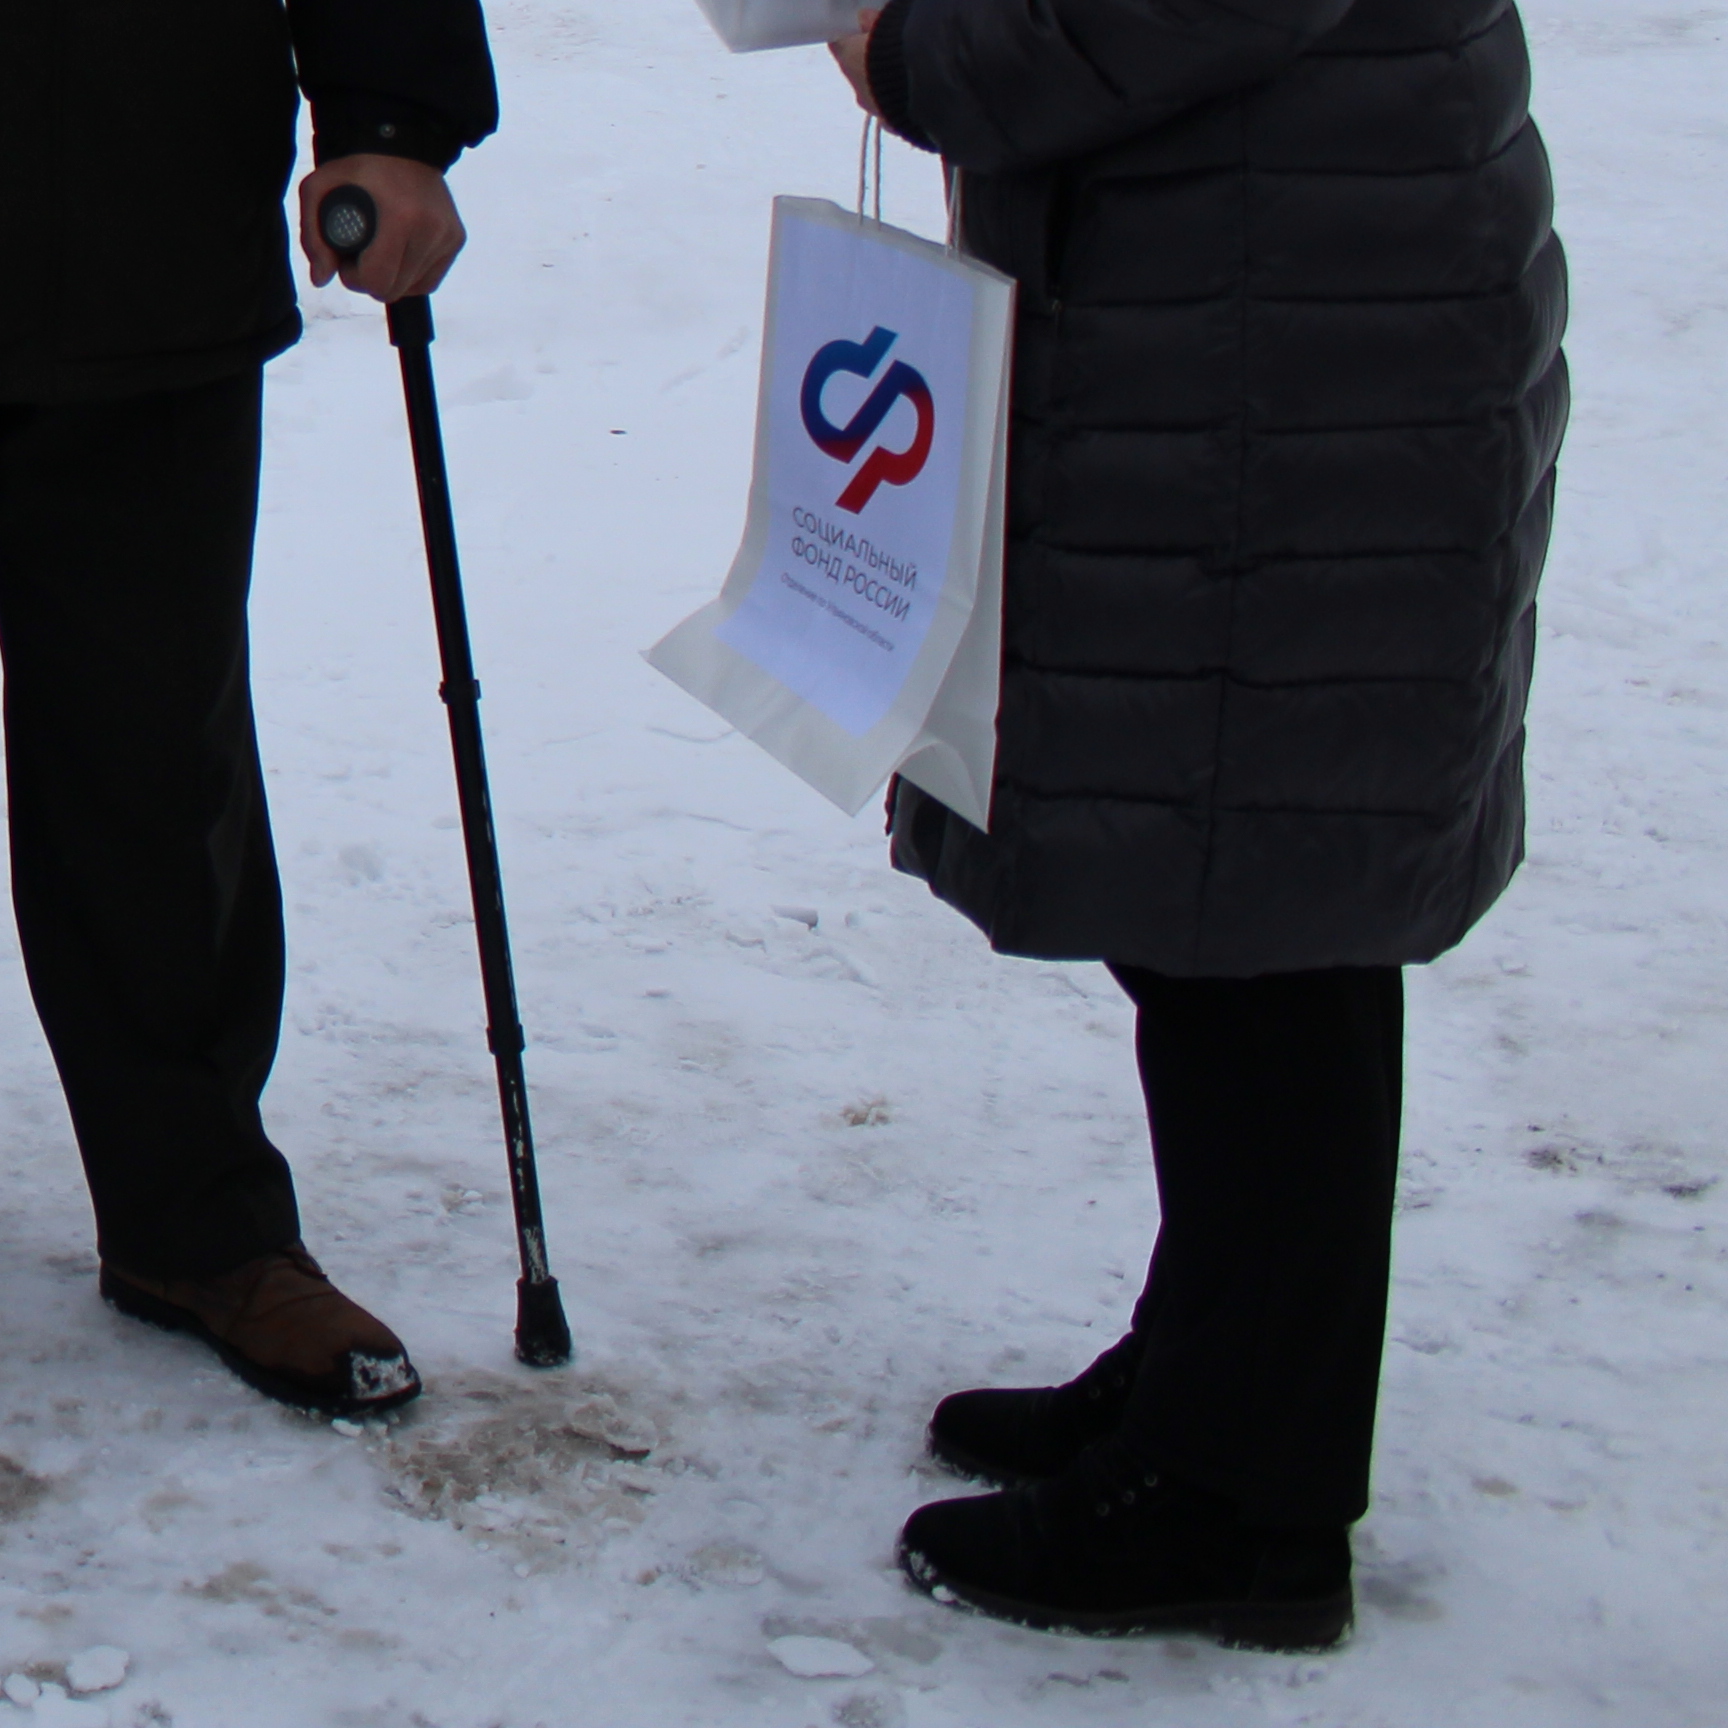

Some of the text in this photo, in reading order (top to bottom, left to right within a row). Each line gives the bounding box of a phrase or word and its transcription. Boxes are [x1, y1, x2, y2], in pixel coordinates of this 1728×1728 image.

[792, 506, 918, 591] СОЦИАЛЬНЫЙ
[792, 537, 911, 622] ФОНД РОССИИ
